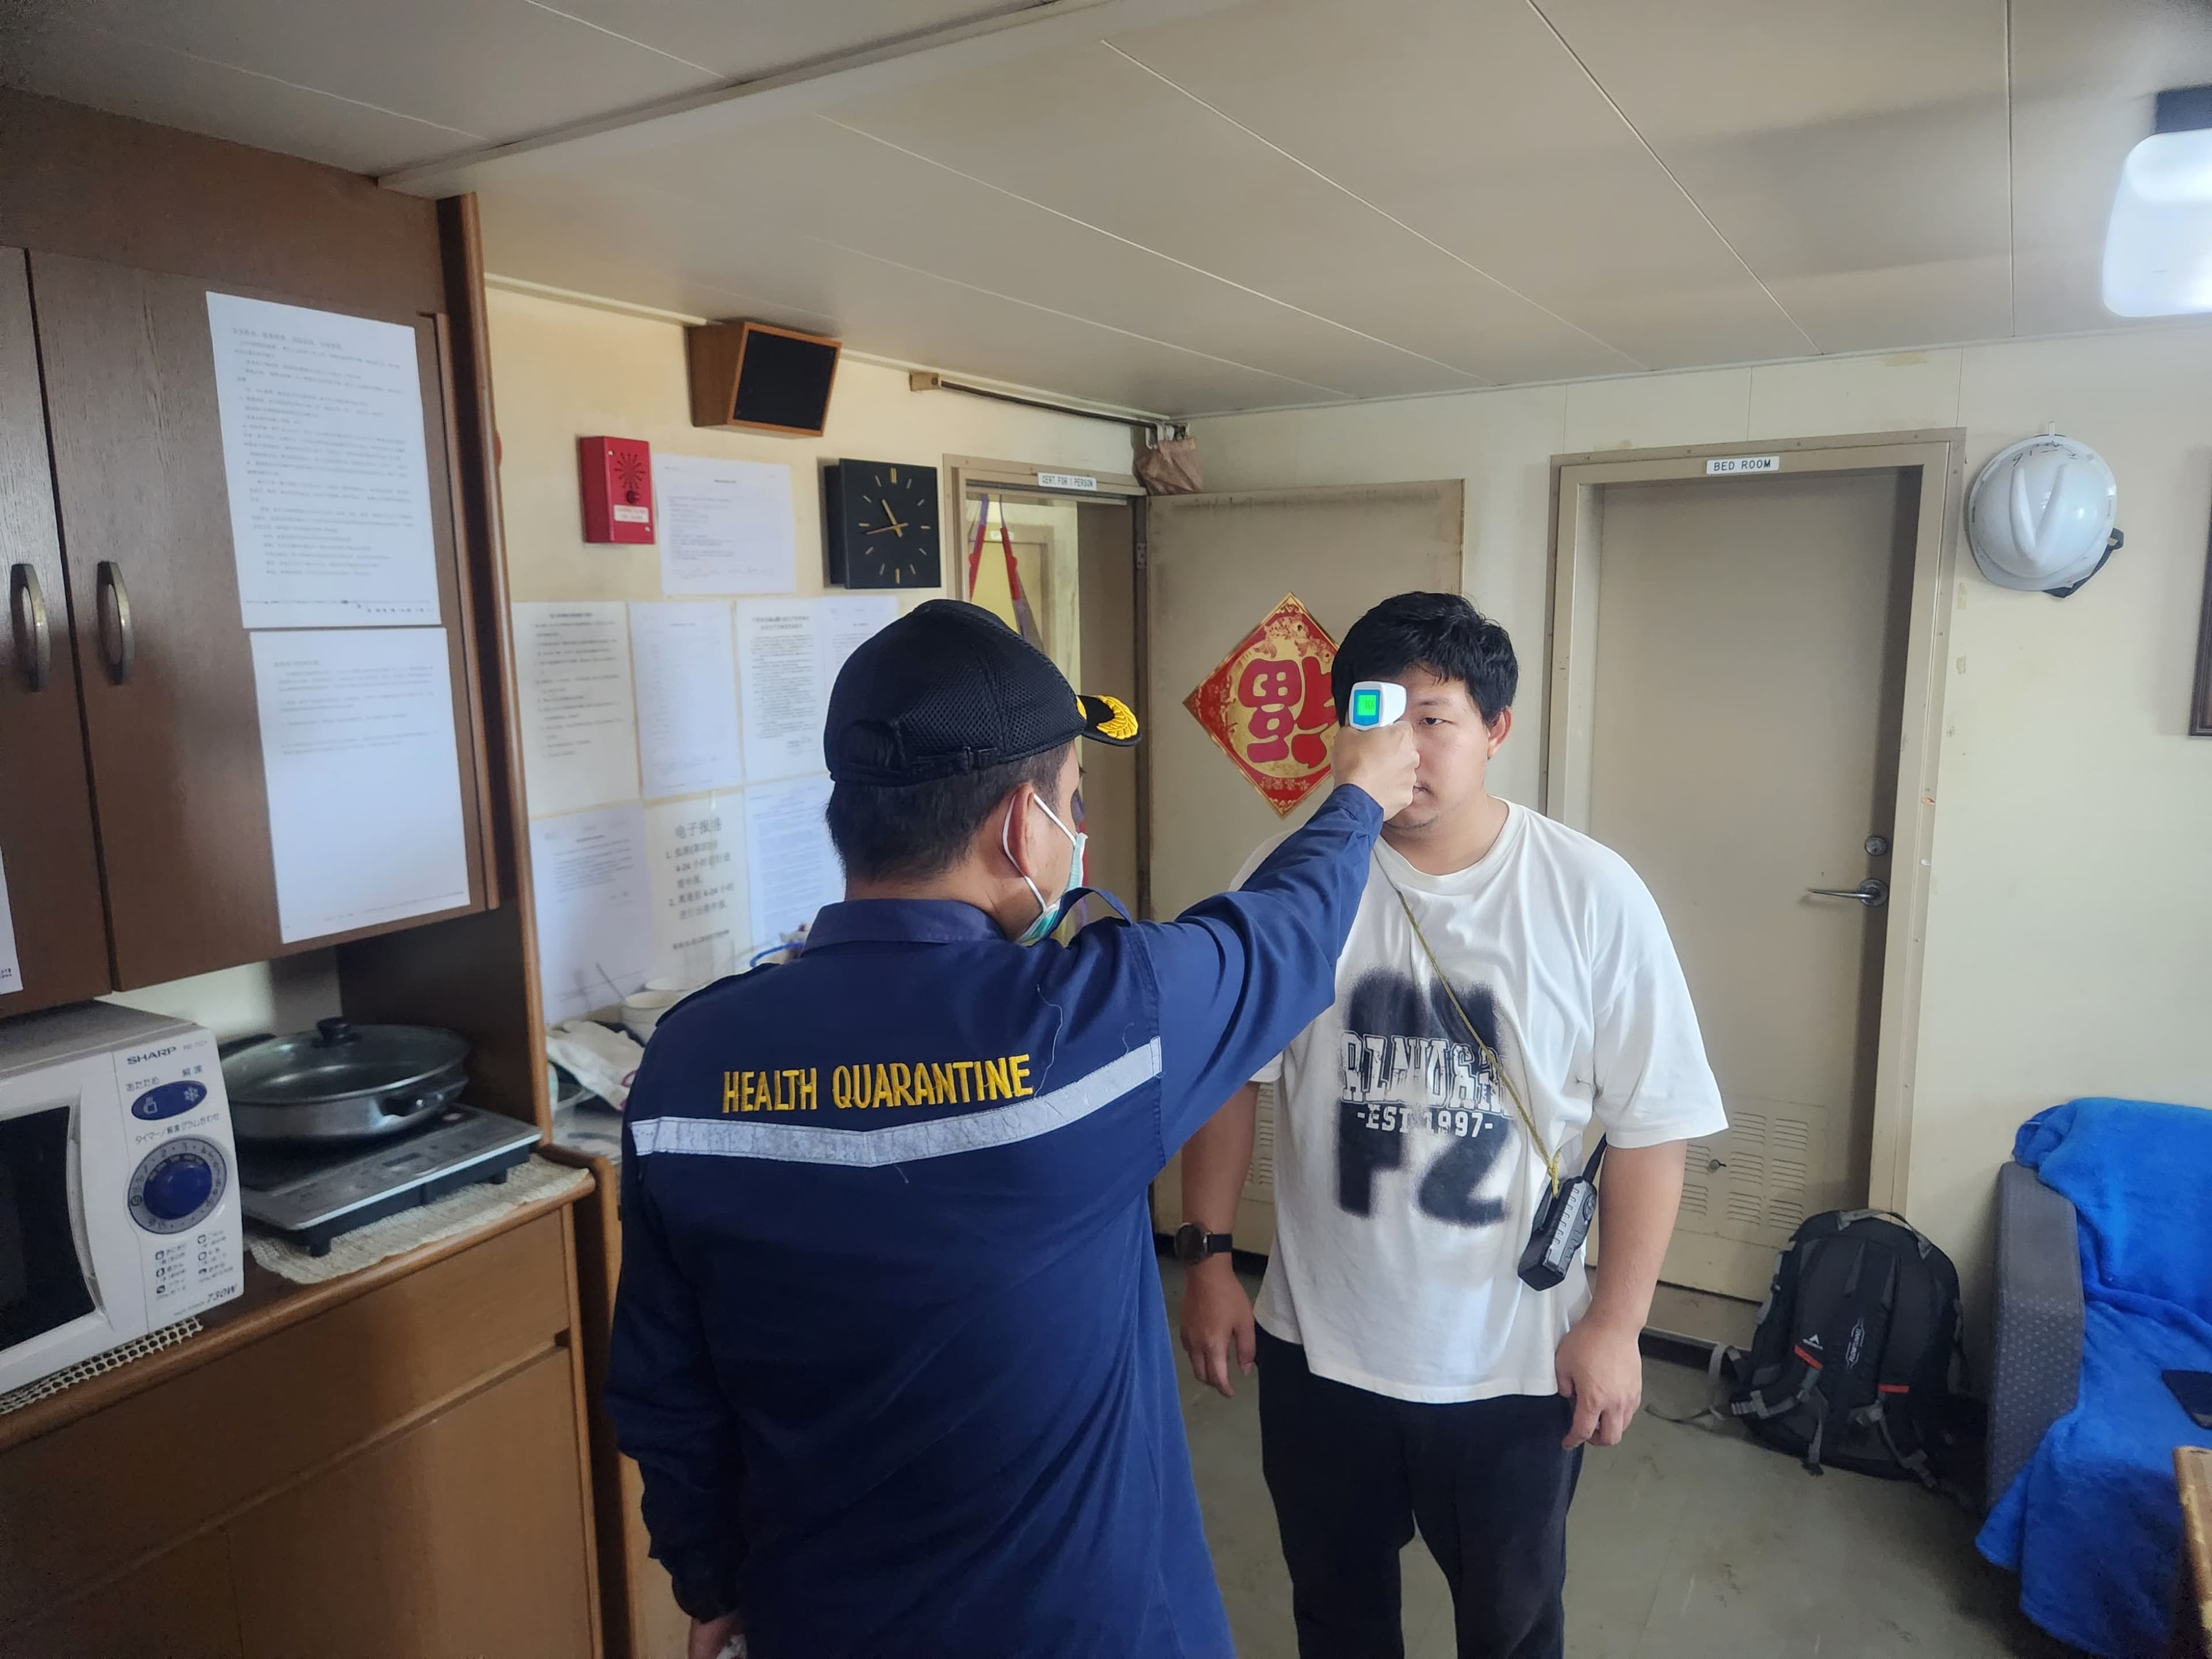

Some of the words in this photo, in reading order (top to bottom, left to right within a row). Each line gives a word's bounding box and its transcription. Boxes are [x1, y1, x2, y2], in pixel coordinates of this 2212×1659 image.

[1714, 461, 1735, 471] BED
[1741, 459, 1771, 469] ROOM
[1058, 476, 1068, 485] FOR
[1074, 478, 1093, 487] PERSON
[127, 1046, 177, 1065] SHARP
[722, 1067, 818, 1113] HEALTH
[832, 1054, 1035, 1109] QUARANTINE
